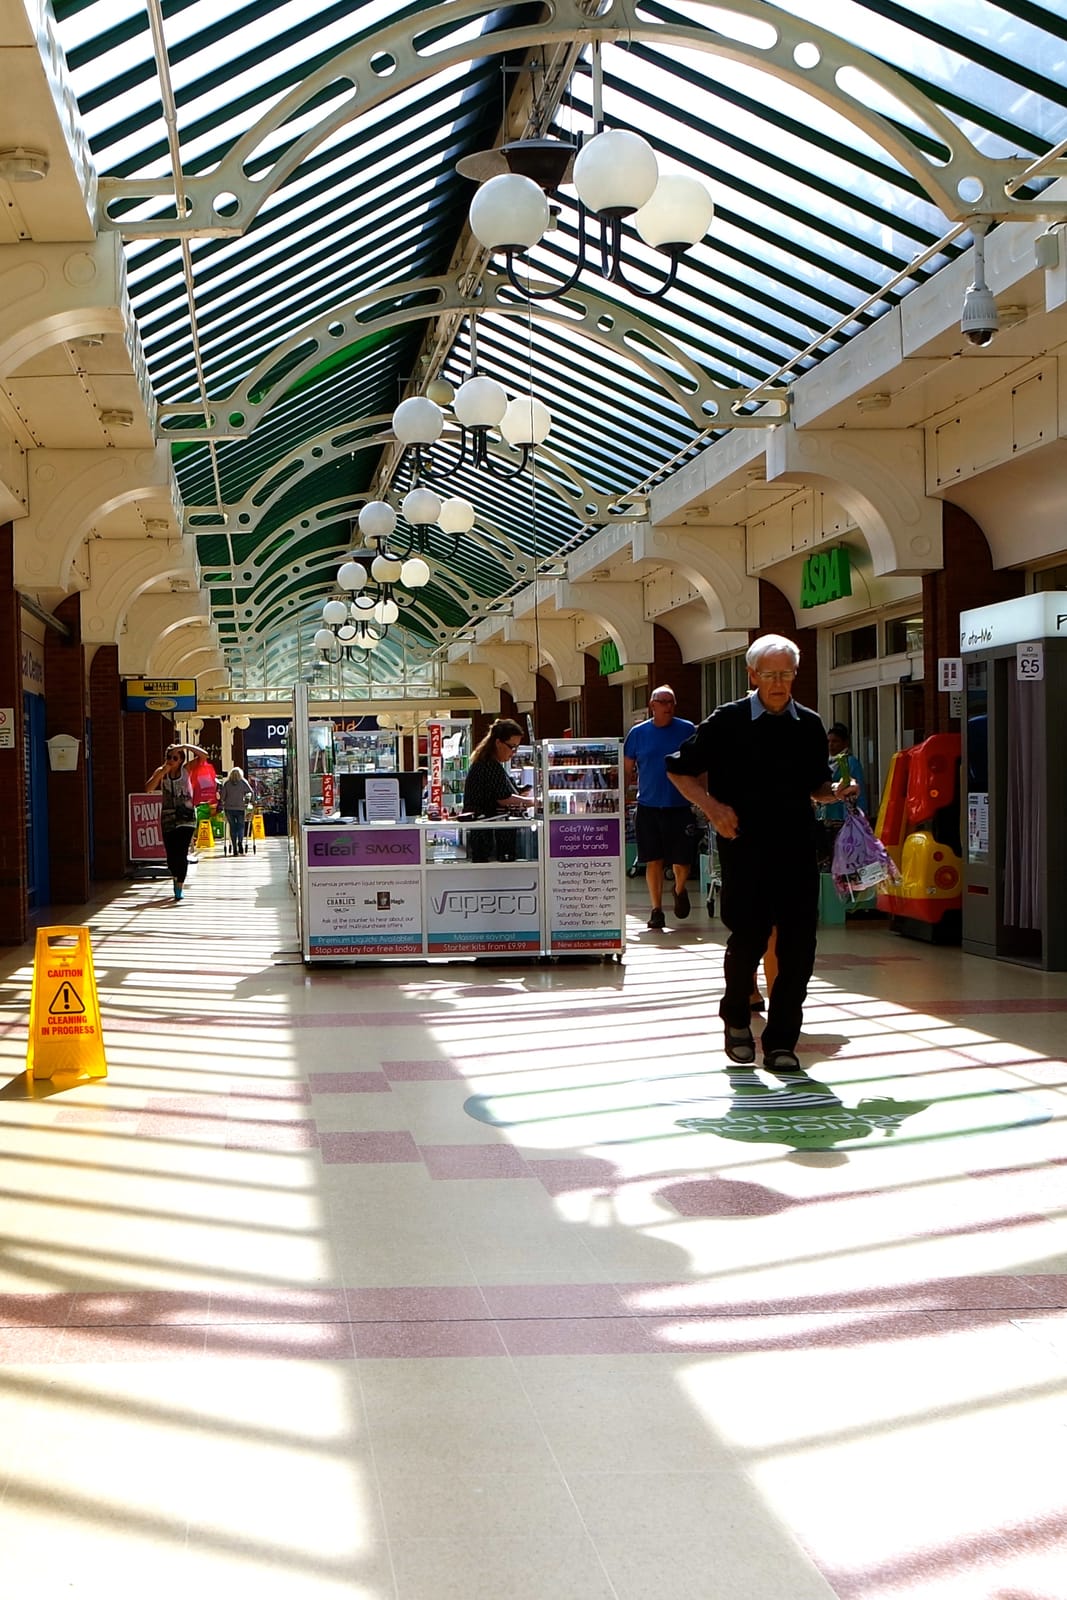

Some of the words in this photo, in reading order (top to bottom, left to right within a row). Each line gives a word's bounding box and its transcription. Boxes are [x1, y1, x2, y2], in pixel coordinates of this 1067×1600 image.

[800, 548, 842, 609] ASDA
[961, 627, 993, 647] Poto-Me
[1020, 659, 1040, 674] £5
[431, 727, 441, 756] SALE
[432, 758, 441, 787] SALE
[324, 776, 332, 804] SALE
[559, 825, 582, 833] Coils?
[596, 824, 609, 832] sell
[137, 826, 163, 848] GOL
[563, 834, 580, 842] coils
[313, 842, 359, 857] Eleaf
[365, 843, 415, 856] SMOK
[560, 844, 581, 852] major
[558, 861, 589, 869] Opening
[431, 883, 537, 919] vapeco
[318, 936, 350, 944] Premium
[352, 936, 377, 944] Liquids
[486, 933, 516, 941] savings!
[315, 947, 331, 955] Stop
[351, 946, 361, 954] try
[377, 945, 392, 953] free
[395, 945, 417, 953] today
[443, 943, 471, 952] Starter
[472, 943, 485, 951] kits
[47, 968, 83, 978] CAUTION
[47, 1015, 87, 1025] CLEANING
[41, 1027, 50, 1036] IN
[52, 1025, 95, 1035] PROGRESS
